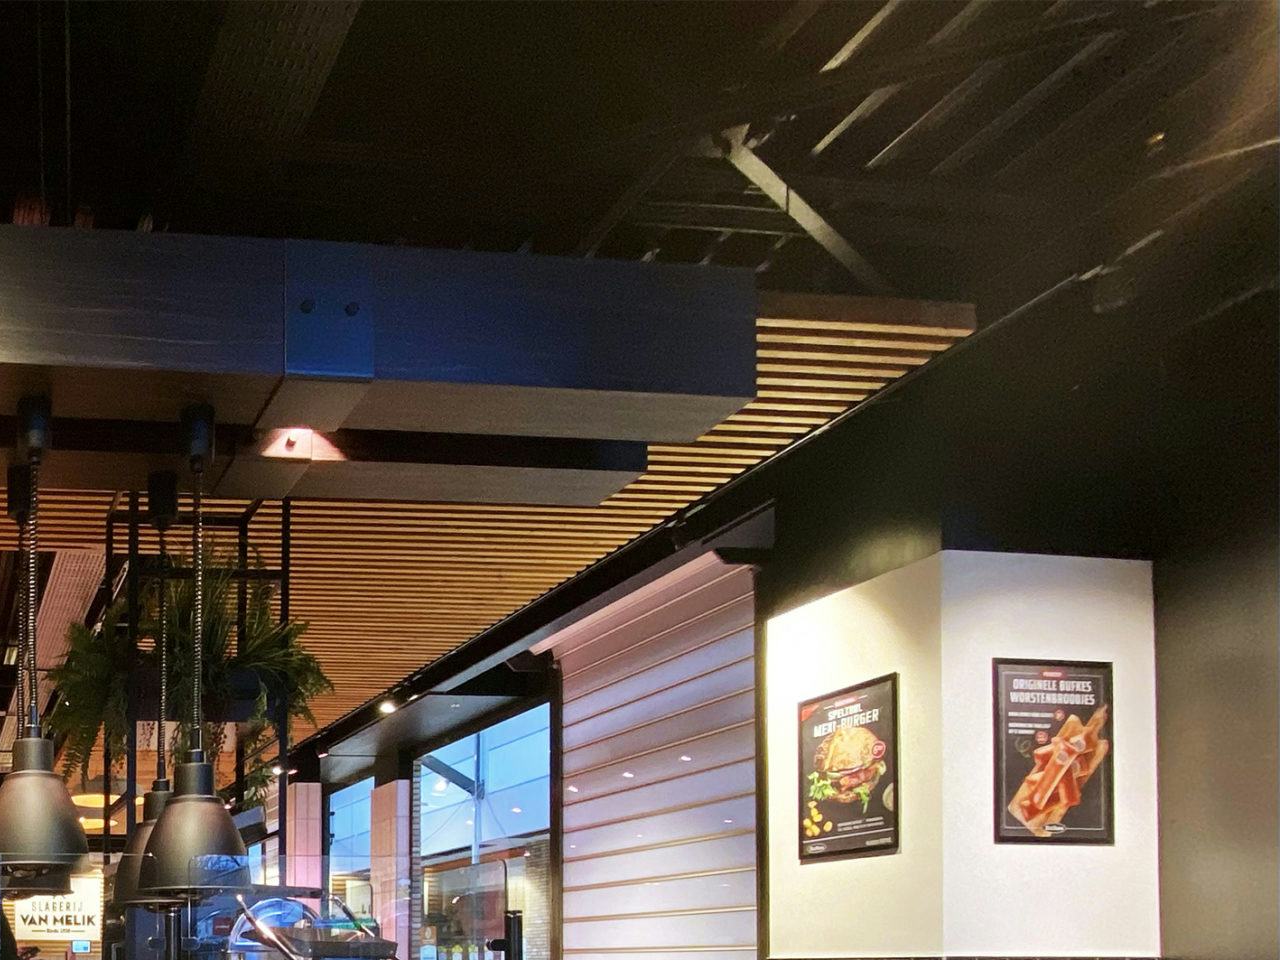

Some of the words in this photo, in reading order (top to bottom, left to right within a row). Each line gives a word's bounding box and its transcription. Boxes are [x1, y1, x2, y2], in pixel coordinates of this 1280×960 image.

[31, 901, 84, 912] SLAGERIJ
[20, 914, 49, 926] VAN
[52, 914, 97, 926] MELIK
